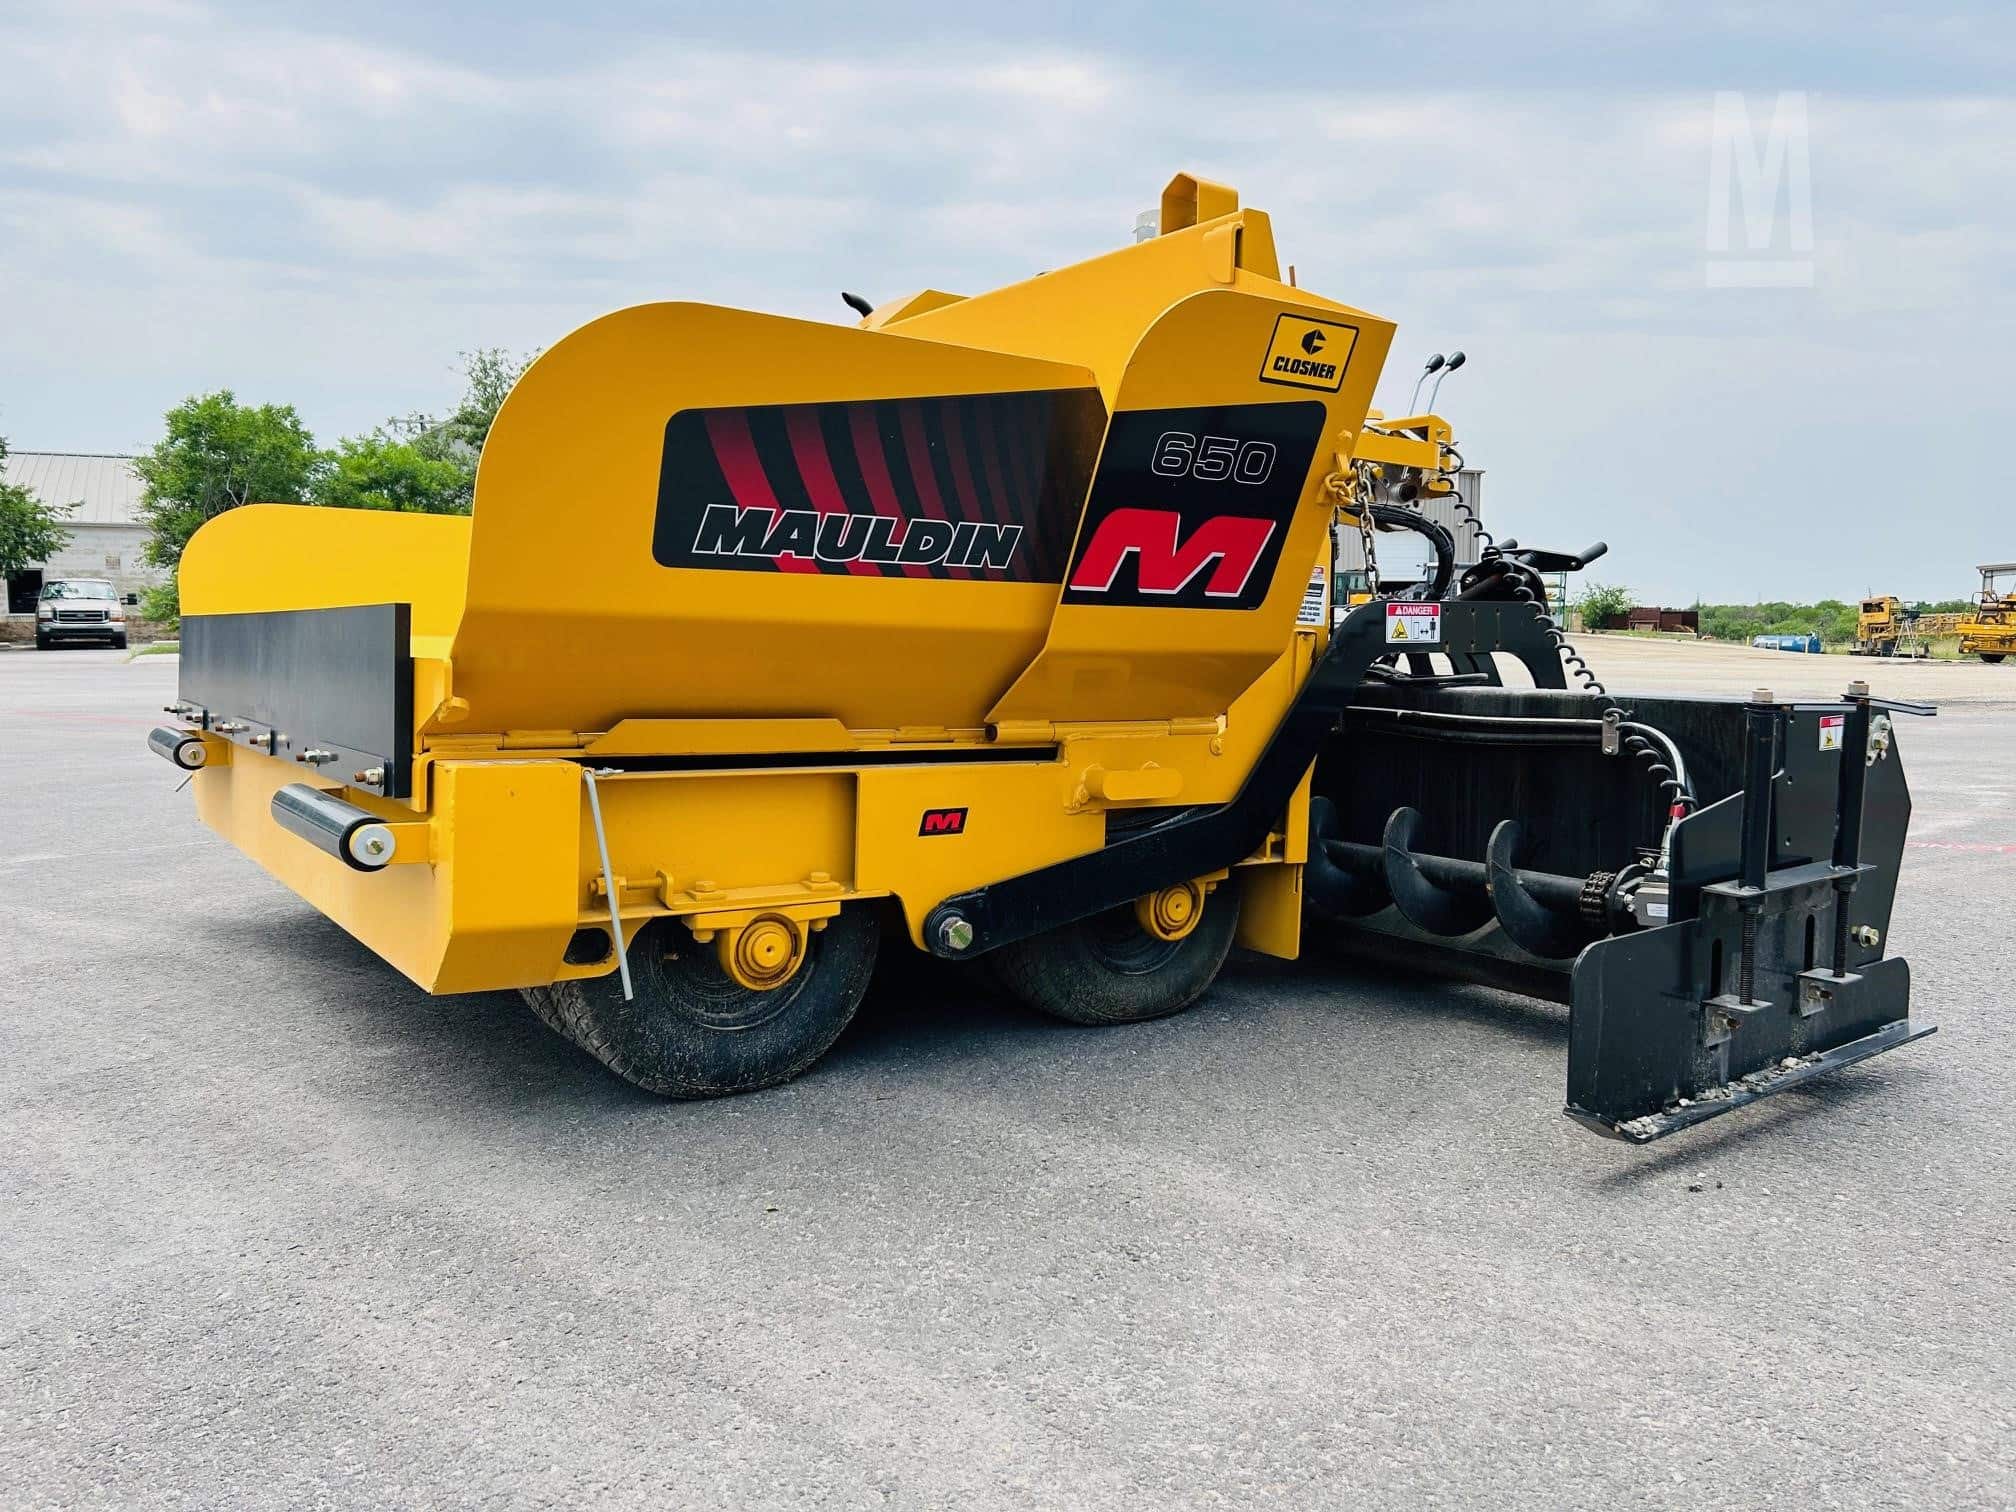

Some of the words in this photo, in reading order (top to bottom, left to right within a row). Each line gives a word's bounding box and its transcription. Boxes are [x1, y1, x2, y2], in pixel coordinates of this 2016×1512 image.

[1273, 356, 1336, 379] CLOSNER
[1152, 432, 1276, 484] 650
[692, 504, 1023, 569] MAULDIN
[1069, 508, 1276, 597] M
[1403, 606, 1432, 615] DANGER
[925, 812, 961, 831] M
